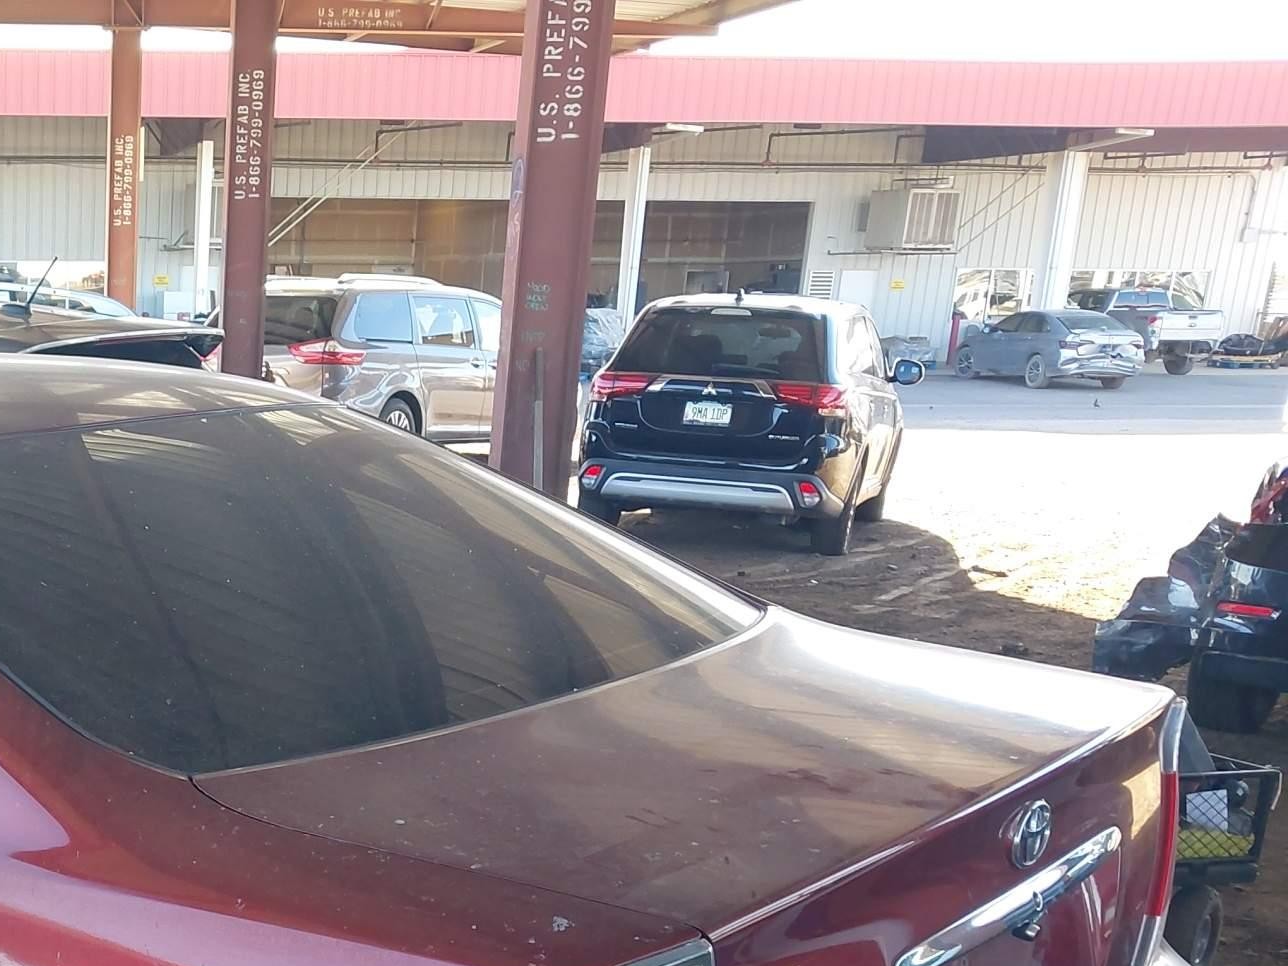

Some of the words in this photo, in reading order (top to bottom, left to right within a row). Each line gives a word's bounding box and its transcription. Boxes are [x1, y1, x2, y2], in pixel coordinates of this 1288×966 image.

[236, 105, 250, 163] PREFAB
[248, 69, 265, 198] 1-866-799-0969
[536, 94, 560, 142] U.S.
[115, 134, 125, 155] INC.
[114, 160, 124, 200] PREFAB
[234, 171, 248, 200] U.S.
[113, 205, 123, 226] U.S.
